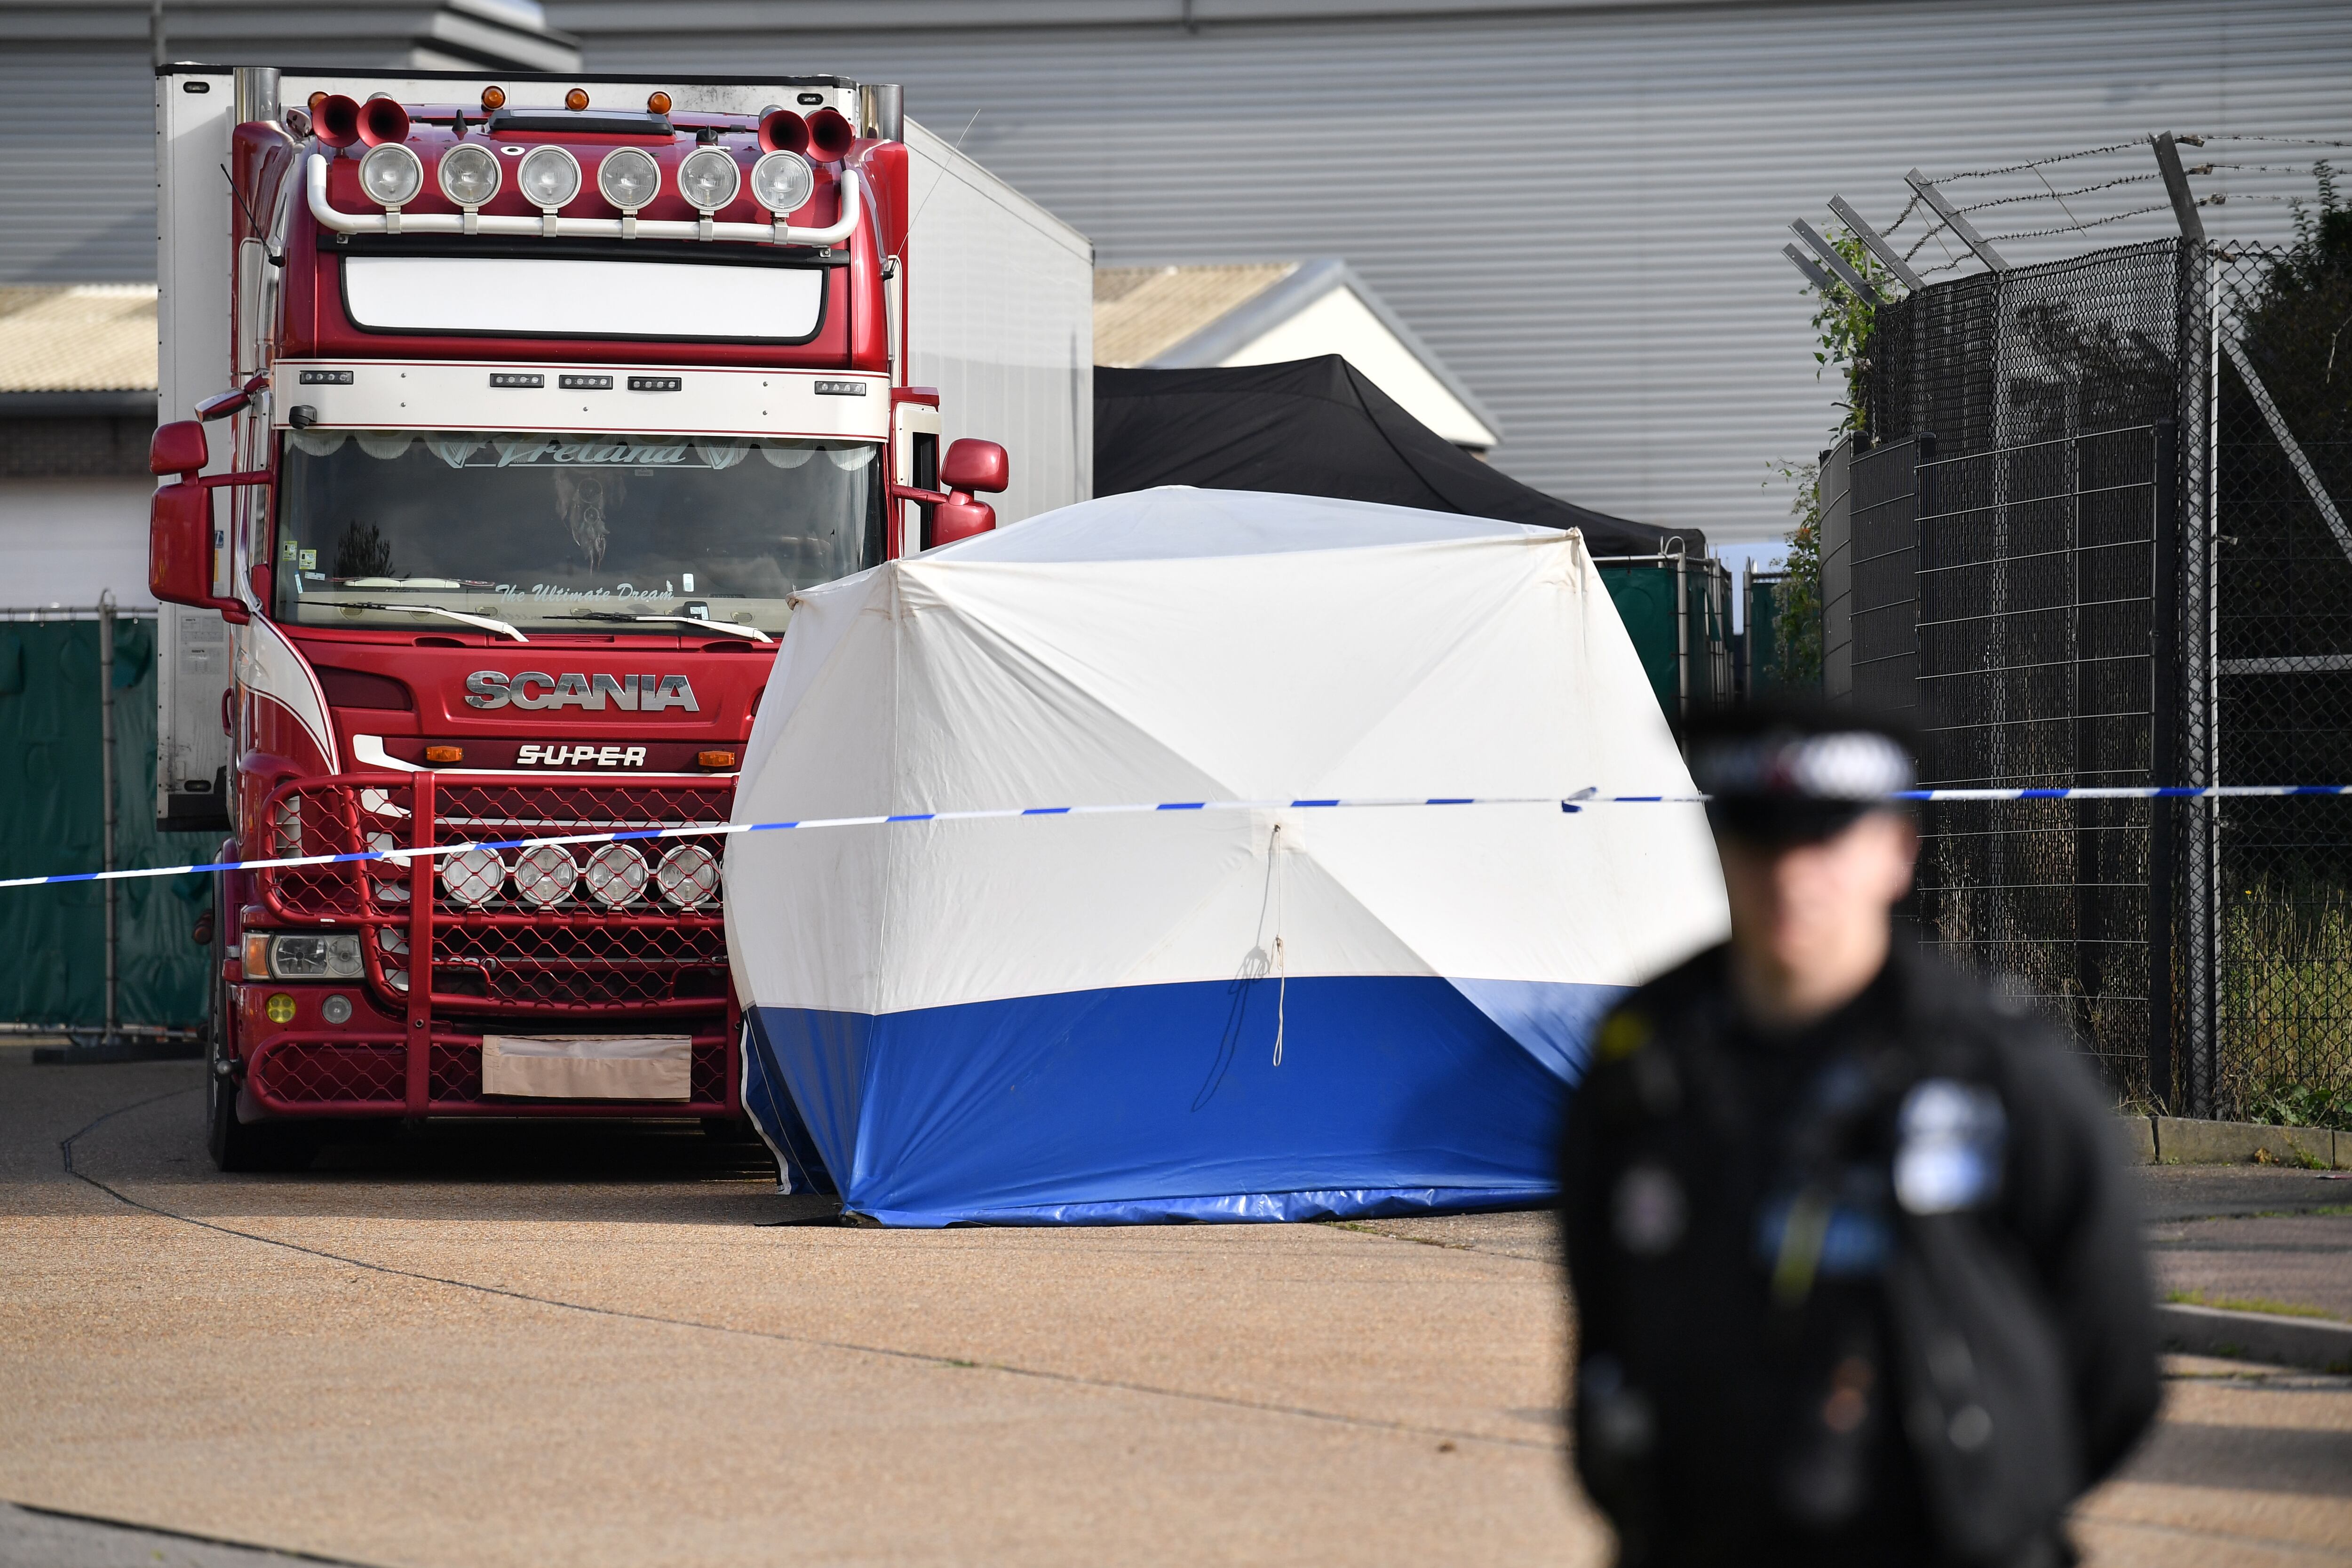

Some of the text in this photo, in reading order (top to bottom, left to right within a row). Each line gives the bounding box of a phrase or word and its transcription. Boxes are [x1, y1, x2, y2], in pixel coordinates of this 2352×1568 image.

[495, 583, 674, 604] The Ultimate Dream
[464, 670, 700, 711] SCANIA
[517, 745, 647, 766] SUPER
